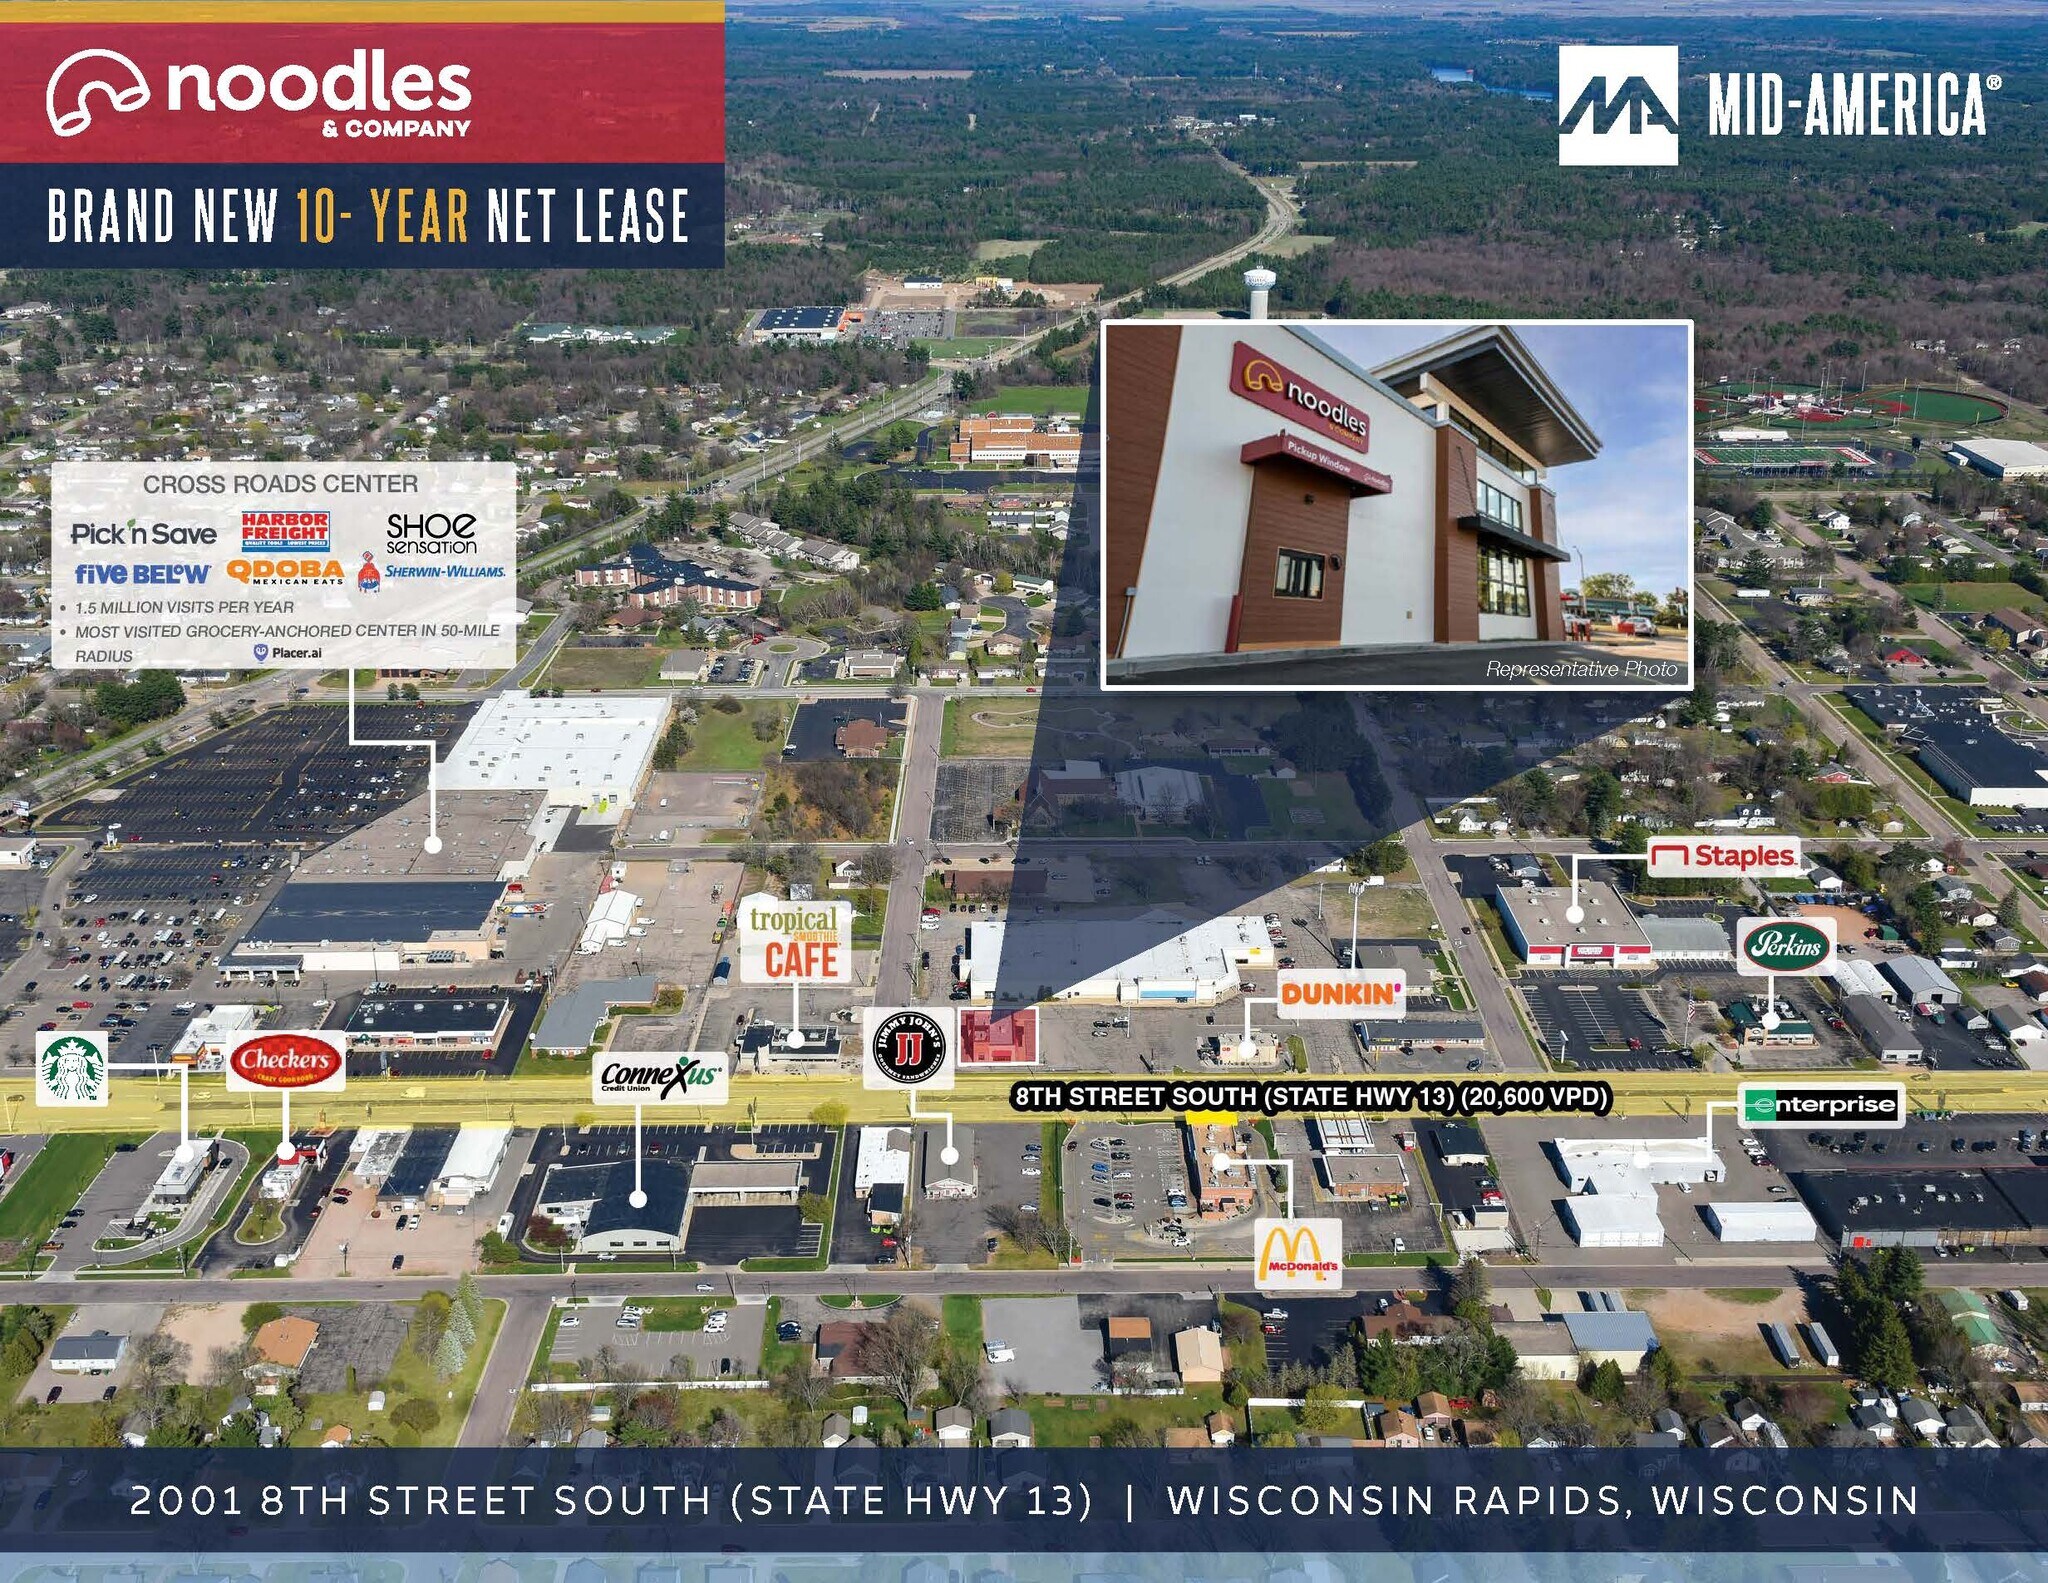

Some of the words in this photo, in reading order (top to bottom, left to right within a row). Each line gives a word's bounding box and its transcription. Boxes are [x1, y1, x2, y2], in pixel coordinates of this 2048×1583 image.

[1287, 381, 1367, 437] noodles
[1288, 441, 1318, 461] Pickup
[1319, 452, 1351, 474] Window
